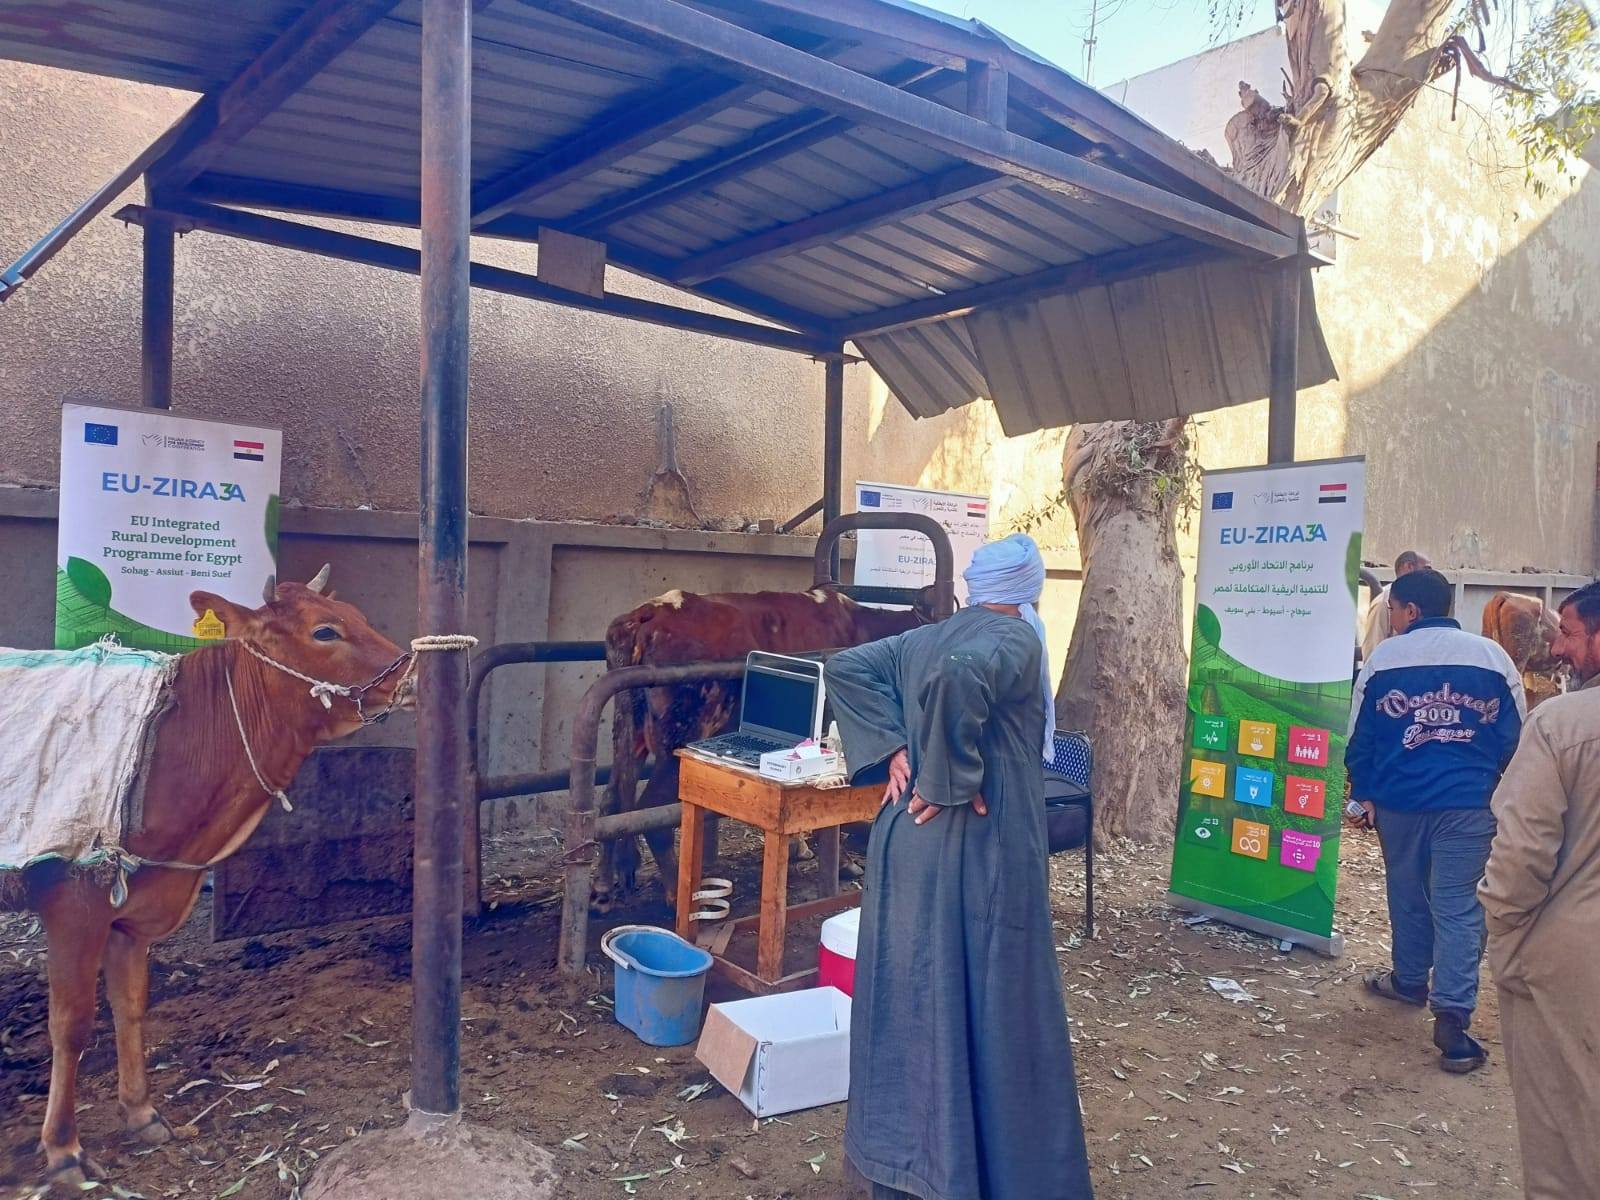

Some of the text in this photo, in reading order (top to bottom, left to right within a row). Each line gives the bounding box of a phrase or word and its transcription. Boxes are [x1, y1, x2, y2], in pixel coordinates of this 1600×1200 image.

[102, 472, 246, 502] EU-ZIRA3A
[131, 515, 220, 532] EU Integrated
[111, 530, 236, 548] Rural Development
[1220, 523, 1327, 544] EU-ZIRA3A
[103, 547, 242, 566] Programme for Egypt
[898, 555, 936, 565] EU-ZIRA
[121, 566, 149, 576] Sohag
[156, 568, 184, 577] Assiut
[191, 569, 210, 577] Beni
[212, 570, 232, 578] Suef
[1229, 558, 1314, 574] برنامج الاتحاد الأوروبي
[1213, 584, 1328, 596] للتنمية الريفية المتكاملة لمصر
[1224, 607, 1244, 615] سويف
[1262, 605, 1284, 616] أسيوط
[1291, 607, 1312, 618] سوهاج
[1414, 708, 1461, 724] 2001
[1312, 840, 1321, 849] 10
